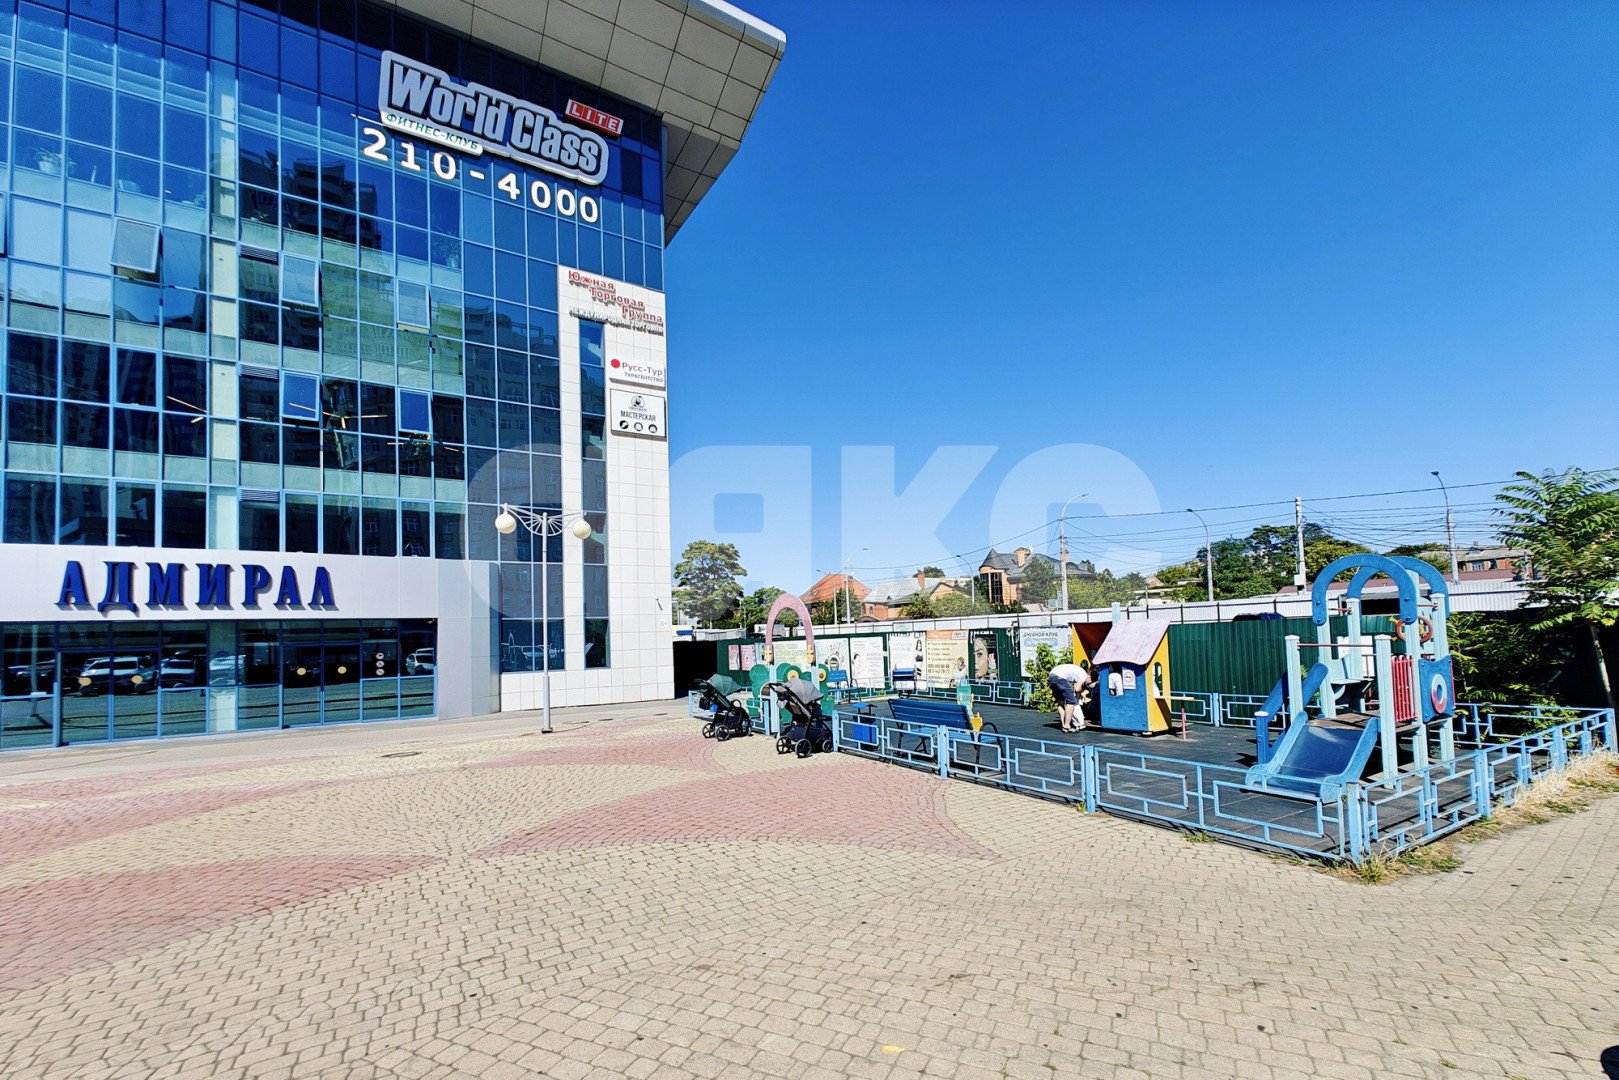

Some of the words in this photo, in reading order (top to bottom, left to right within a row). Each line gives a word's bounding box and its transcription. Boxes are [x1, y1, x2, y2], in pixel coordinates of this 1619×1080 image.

[385, 112, 479, 150] ФИТНЕС-КЛУБ
[389, 61, 510, 143] World
[510, 106, 599, 174] Class
[570, 102, 620, 132] LITE
[362, 126, 599, 223] 210-4000
[568, 270, 614, 290] Южная
[590, 287, 645, 309] Торговая
[621, 305, 663, 323] Группа
[620, 410, 656, 421] МАСТЕРСКАЯ
[56, 560, 336, 613] АДМИРАЛ
